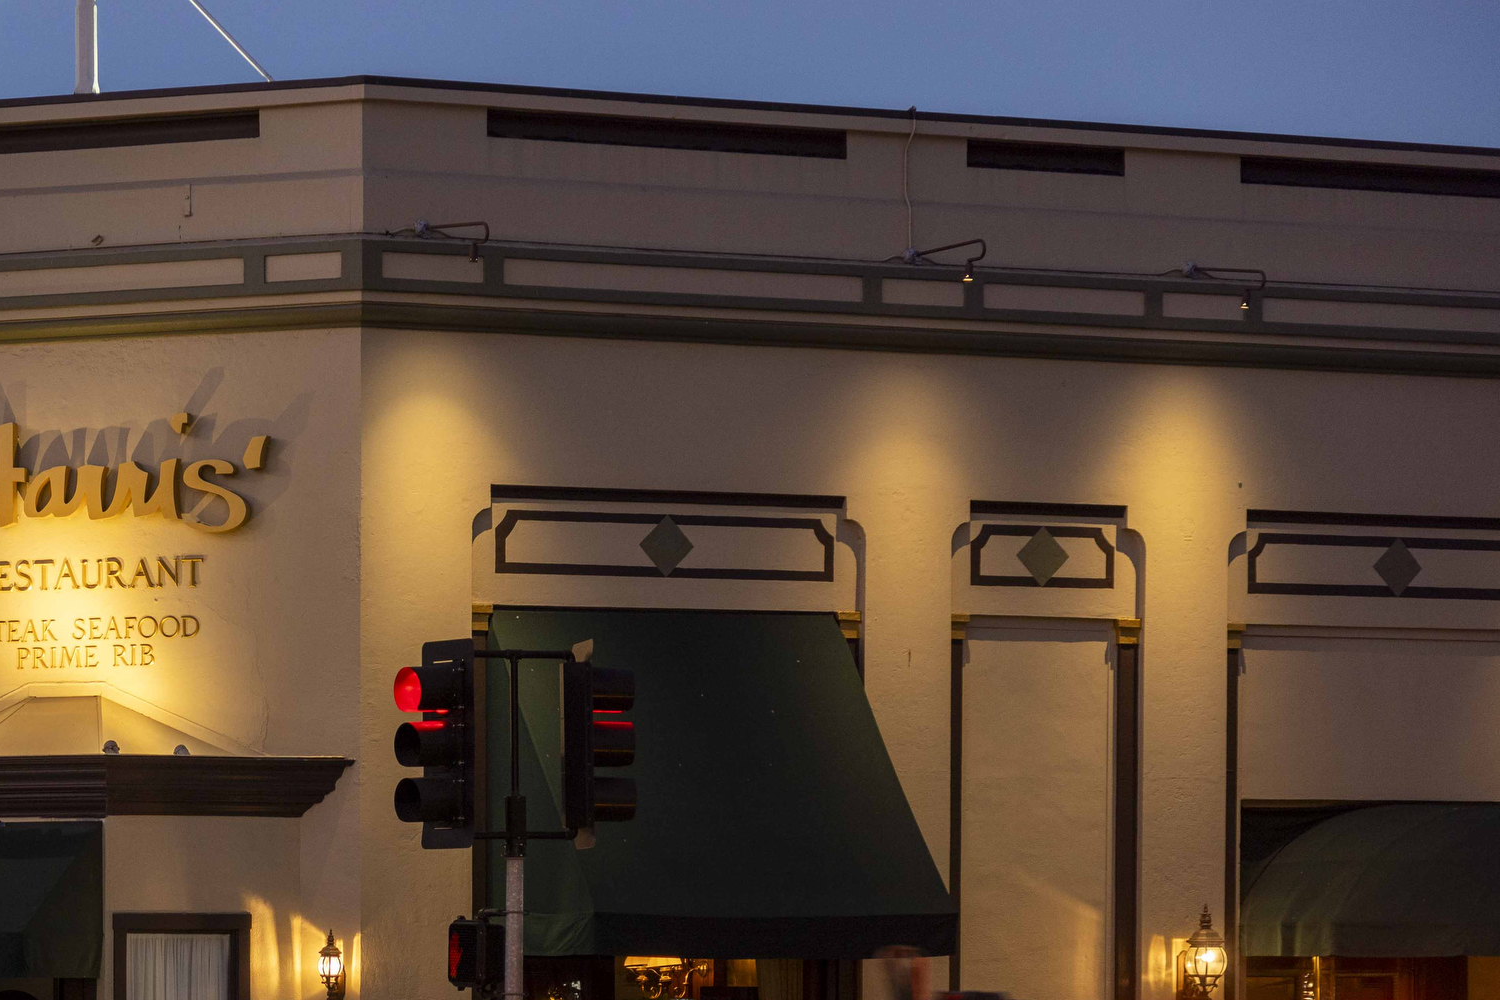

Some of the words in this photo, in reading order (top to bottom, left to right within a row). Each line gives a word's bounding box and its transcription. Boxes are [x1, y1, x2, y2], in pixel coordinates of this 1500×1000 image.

[72, 615, 200, 640] SEAFOOD
[17, 645, 100, 669] PRIME
[112, 643, 156, 667] RIB
